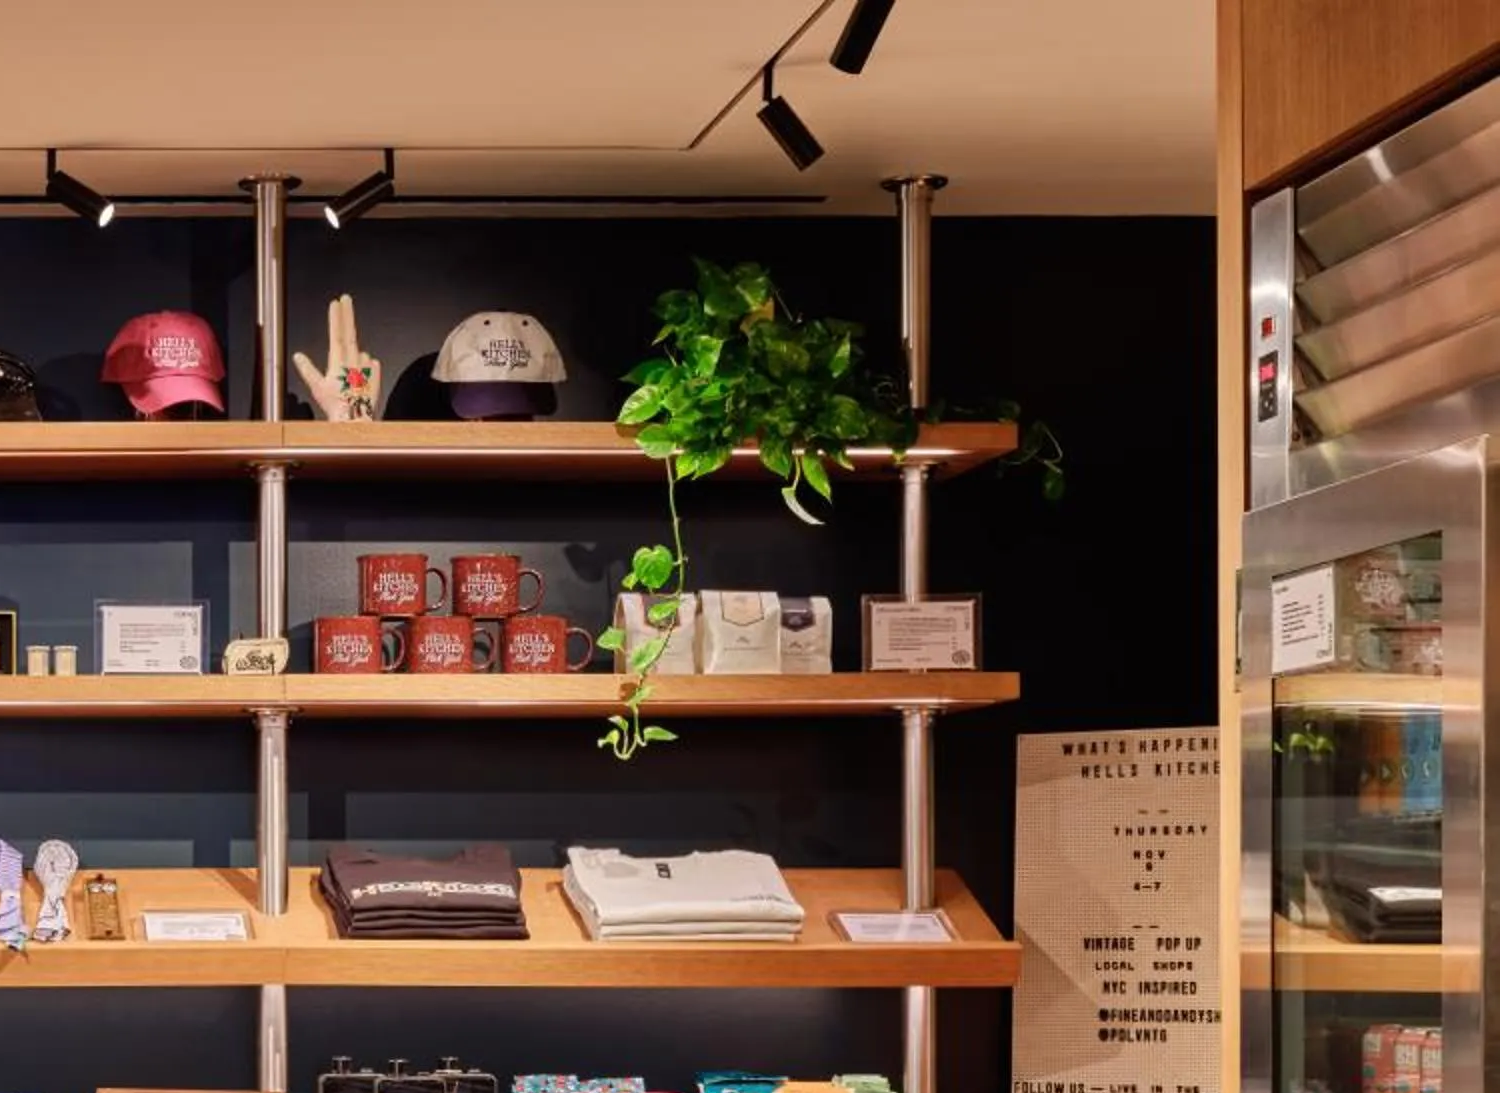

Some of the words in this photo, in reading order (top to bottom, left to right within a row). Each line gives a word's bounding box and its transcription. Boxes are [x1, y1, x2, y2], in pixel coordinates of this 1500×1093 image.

[1081, 763, 1138, 778] HELLS
[1114, 825, 1208, 836] THURSDAY
[1133, 850, 1166, 860] NOV
[1083, 937, 1136, 952] VINTAGE
[1156, 937, 1181, 952] POP
[1185, 937, 1202, 952] UP
[1095, 960, 1135, 972] LOCAL
[1103, 981, 1127, 994] NYC
[1138, 981, 1198, 995] INSPIRED
